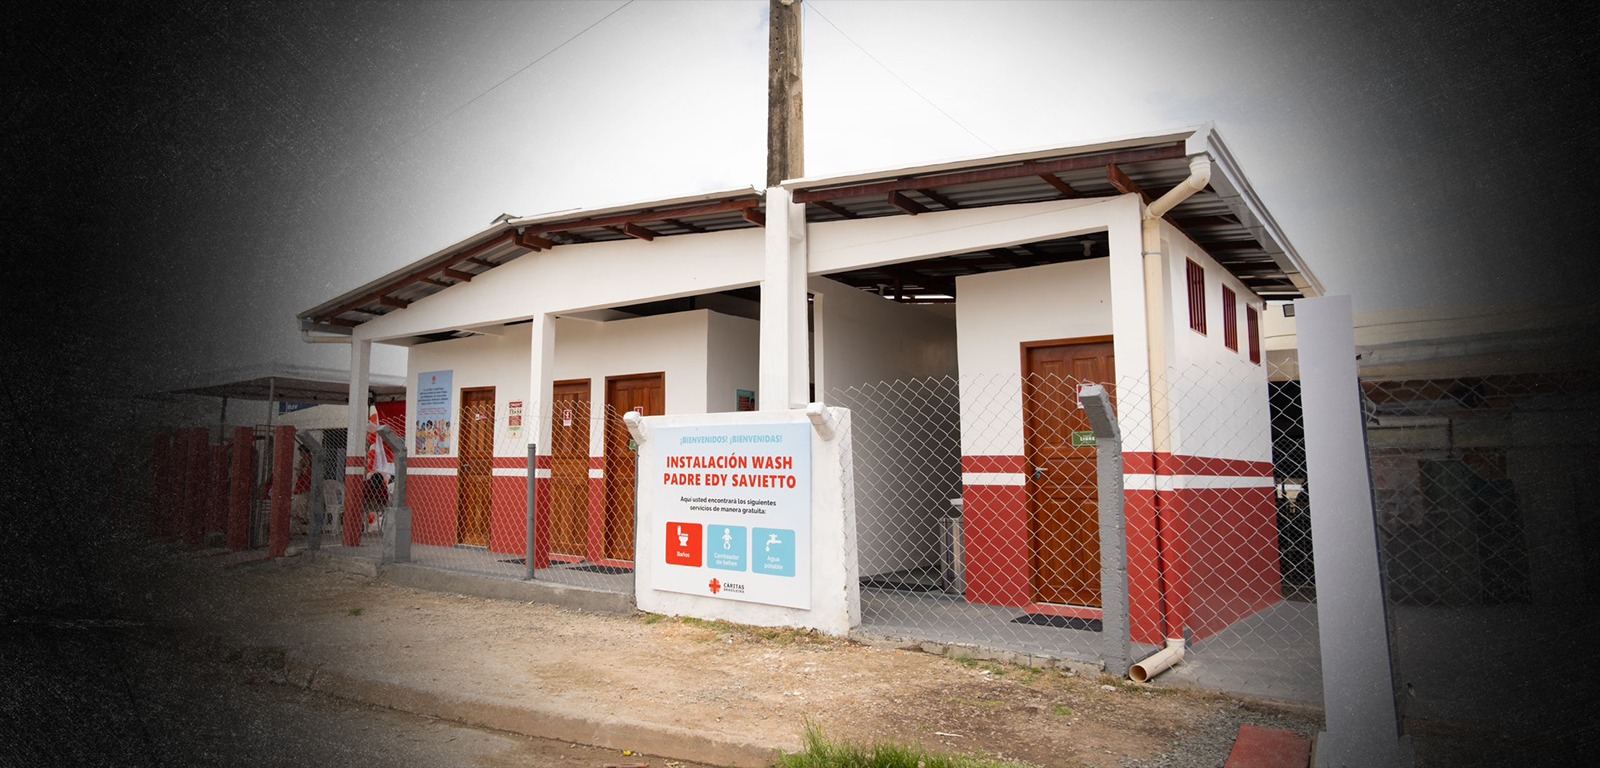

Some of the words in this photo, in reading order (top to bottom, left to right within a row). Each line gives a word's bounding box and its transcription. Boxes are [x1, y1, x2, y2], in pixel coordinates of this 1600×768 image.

[680, 435, 728, 445] ¡BIENVENIDOS!
[729, 434, 783, 445] ¡BIENVENIDAS!
[666, 452, 748, 469] INSTALACIÓN
[751, 456, 793, 470] WASH
[663, 473, 701, 486] PADRE
[705, 474, 728, 486] EDY
[731, 474, 797, 489] SAVIETTO
[747, 499, 777, 507] siguientes
